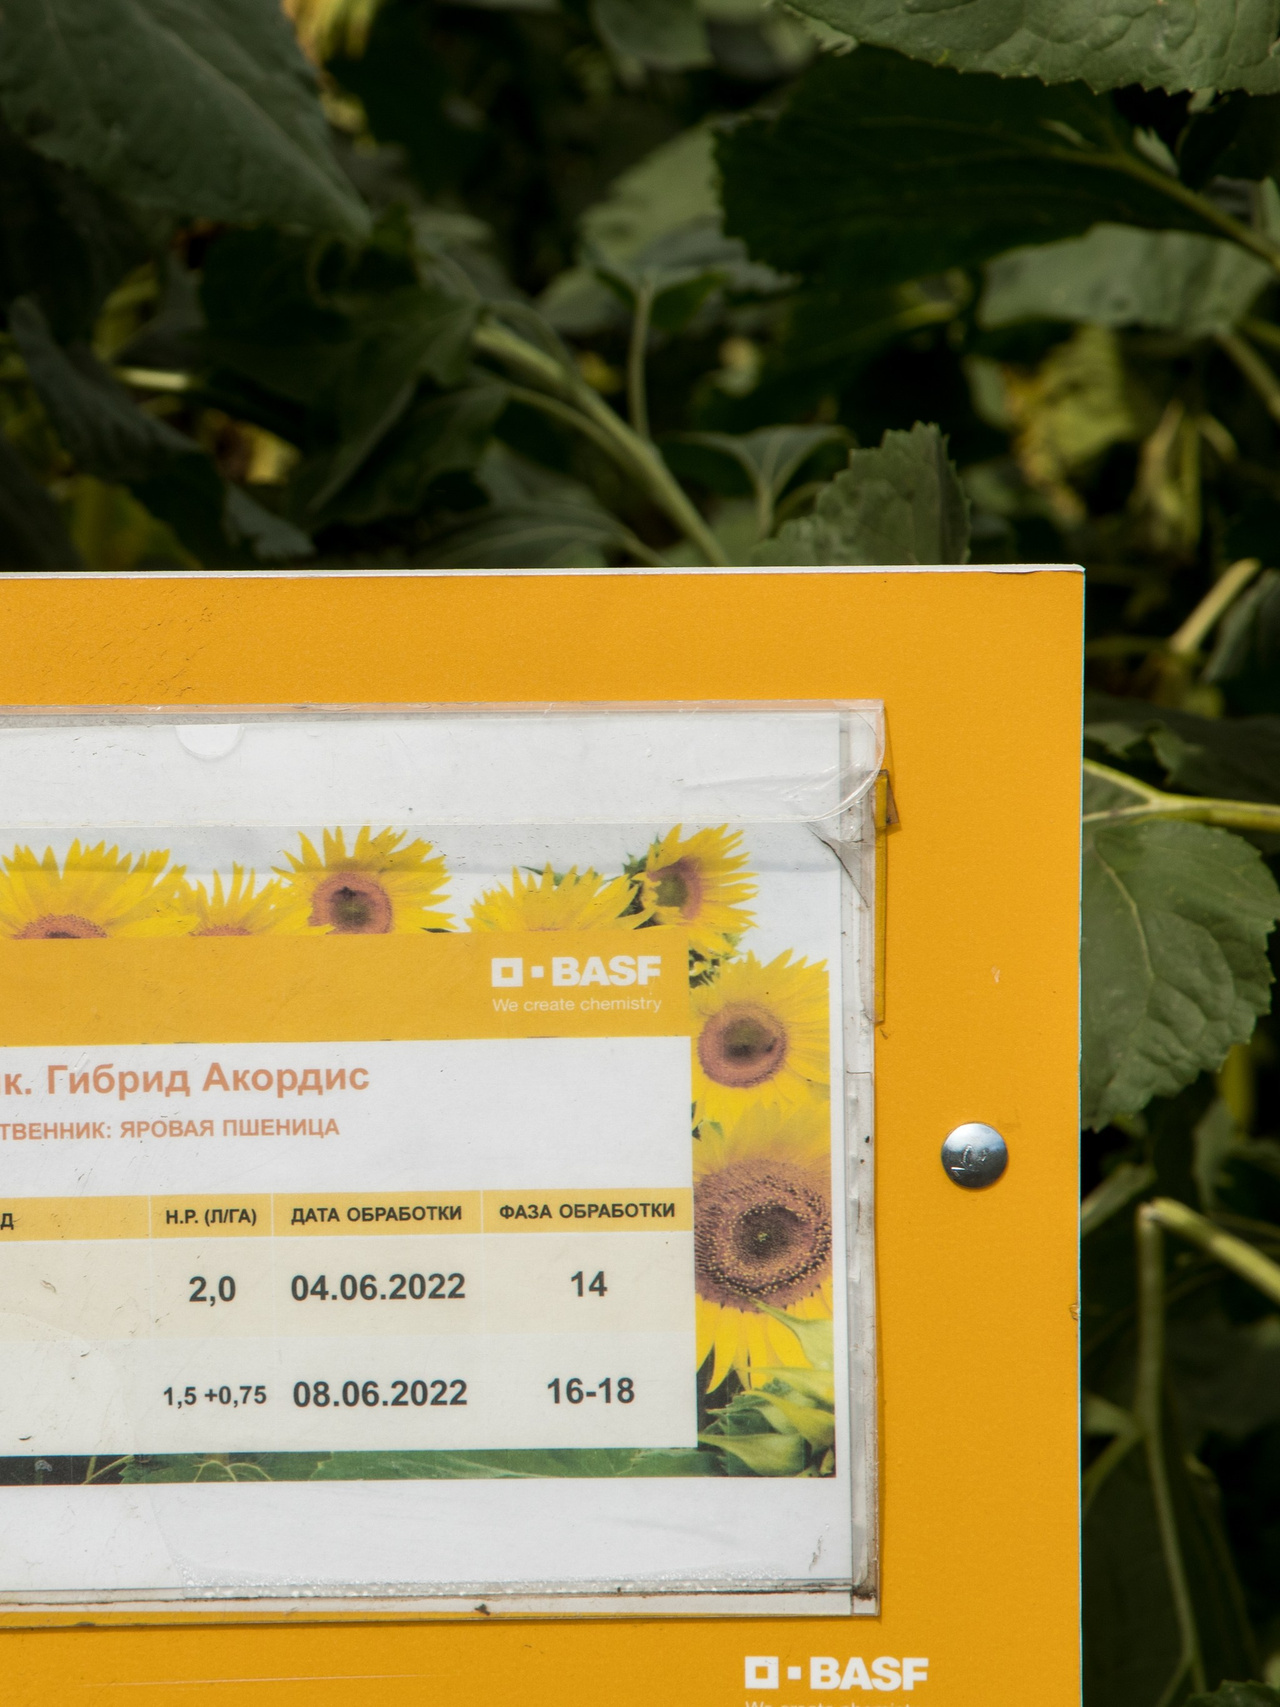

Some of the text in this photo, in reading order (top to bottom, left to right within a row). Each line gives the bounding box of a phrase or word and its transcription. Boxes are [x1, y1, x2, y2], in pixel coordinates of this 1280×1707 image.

[552, 955, 662, 987] BASF
[492, 996, 662, 1014] We create chemistry
[47, 1063, 191, 1101] Гибрид
[202, 1062, 369, 1098] Акордис
[120, 1119, 215, 1139] ЯРОВАЯ
[223, 1118, 340, 1140] ПШЕНИЦА
[166, 1208, 257, 1227] Н.Р. (Л/ГА)
[291, 1205, 462, 1226] ДАТА ОБРАБОТКИ
[499, 1202, 675, 1220] ФАЗА ОБРАБОТКИ
[189, 1275, 236, 1307] 2,0
[291, 1272, 466, 1302] 04.06.2022
[571, 1270, 608, 1297] 14
[163, 1386, 197, 1409] 1,5
[293, 1379, 467, 1408] 08.06.2022
[547, 1377, 635, 1405] 16-18
[809, 1656, 929, 1691] BASF
